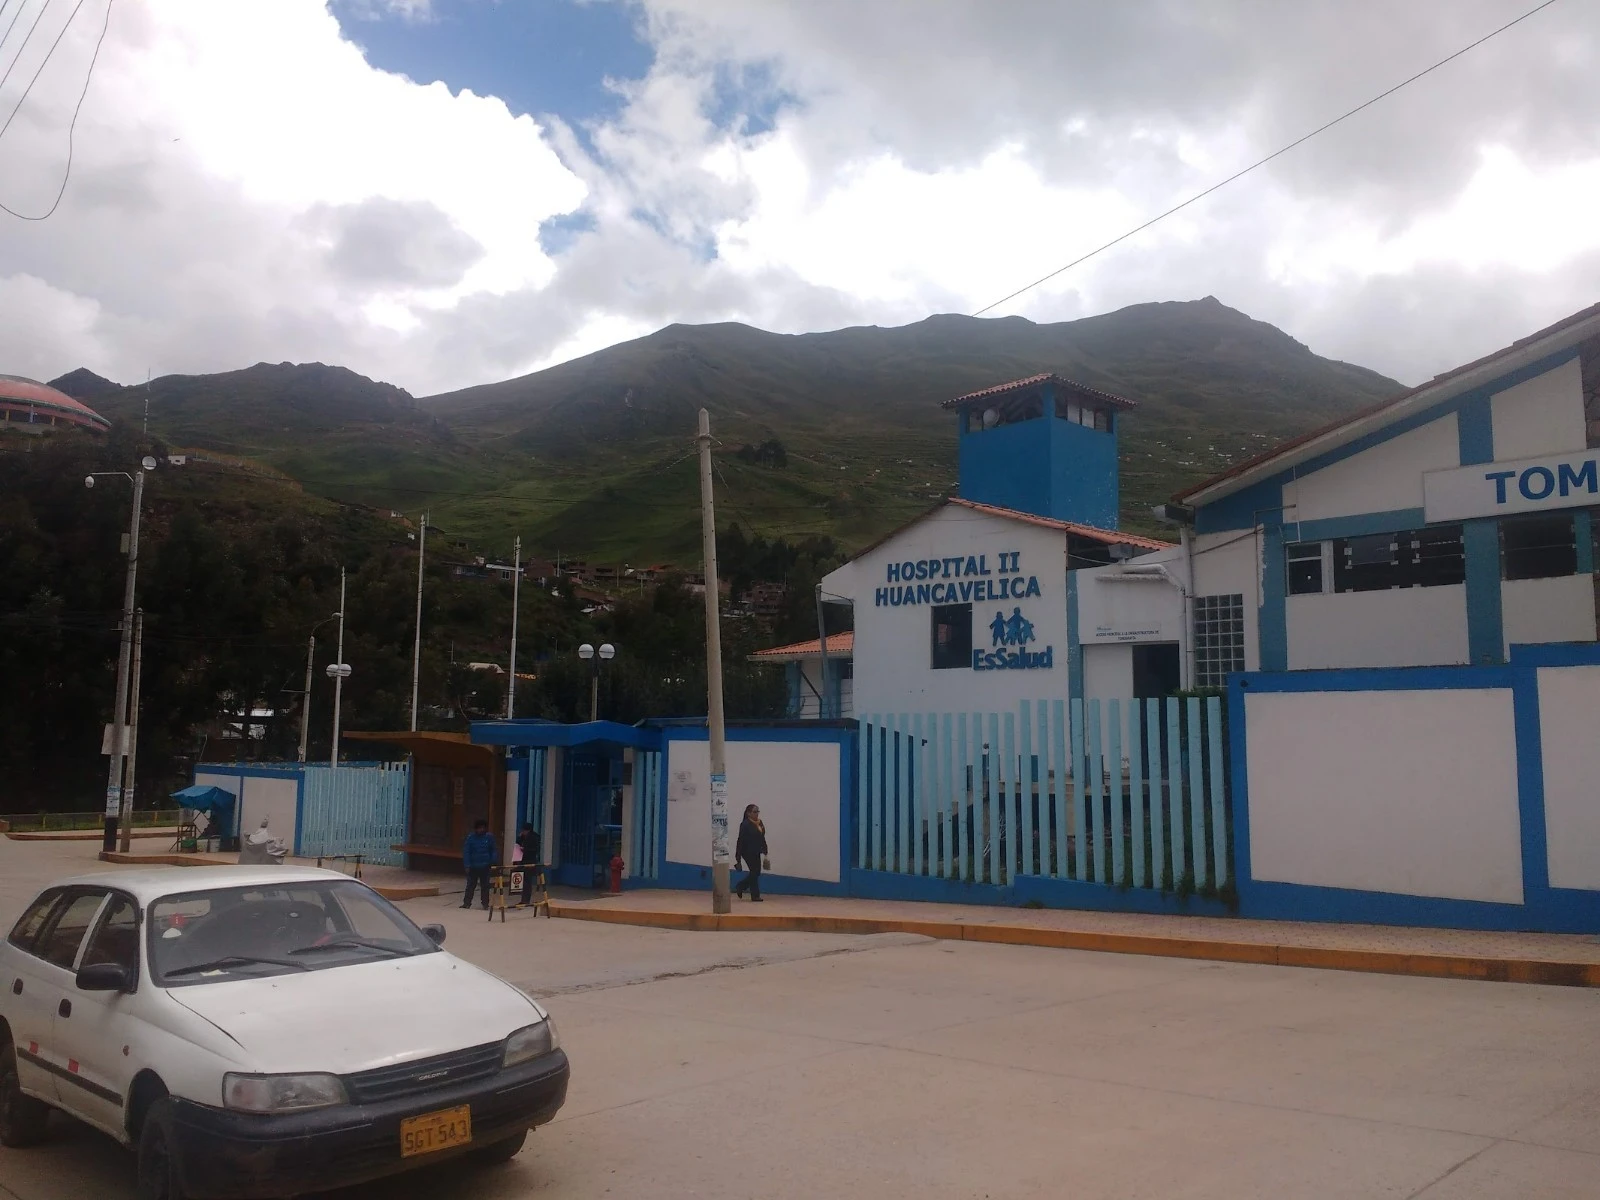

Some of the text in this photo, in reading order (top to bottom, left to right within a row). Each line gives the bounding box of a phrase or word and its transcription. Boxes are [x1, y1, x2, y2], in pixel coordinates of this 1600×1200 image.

[1485, 460, 1598, 504] TOM
[887, 551, 1020, 583] HOSPITAL II
[875, 576, 1041, 607] HUANCAVELICA
[972, 645, 1053, 671] EsSalud
[405, 1120, 468, 1151] SGT 543
